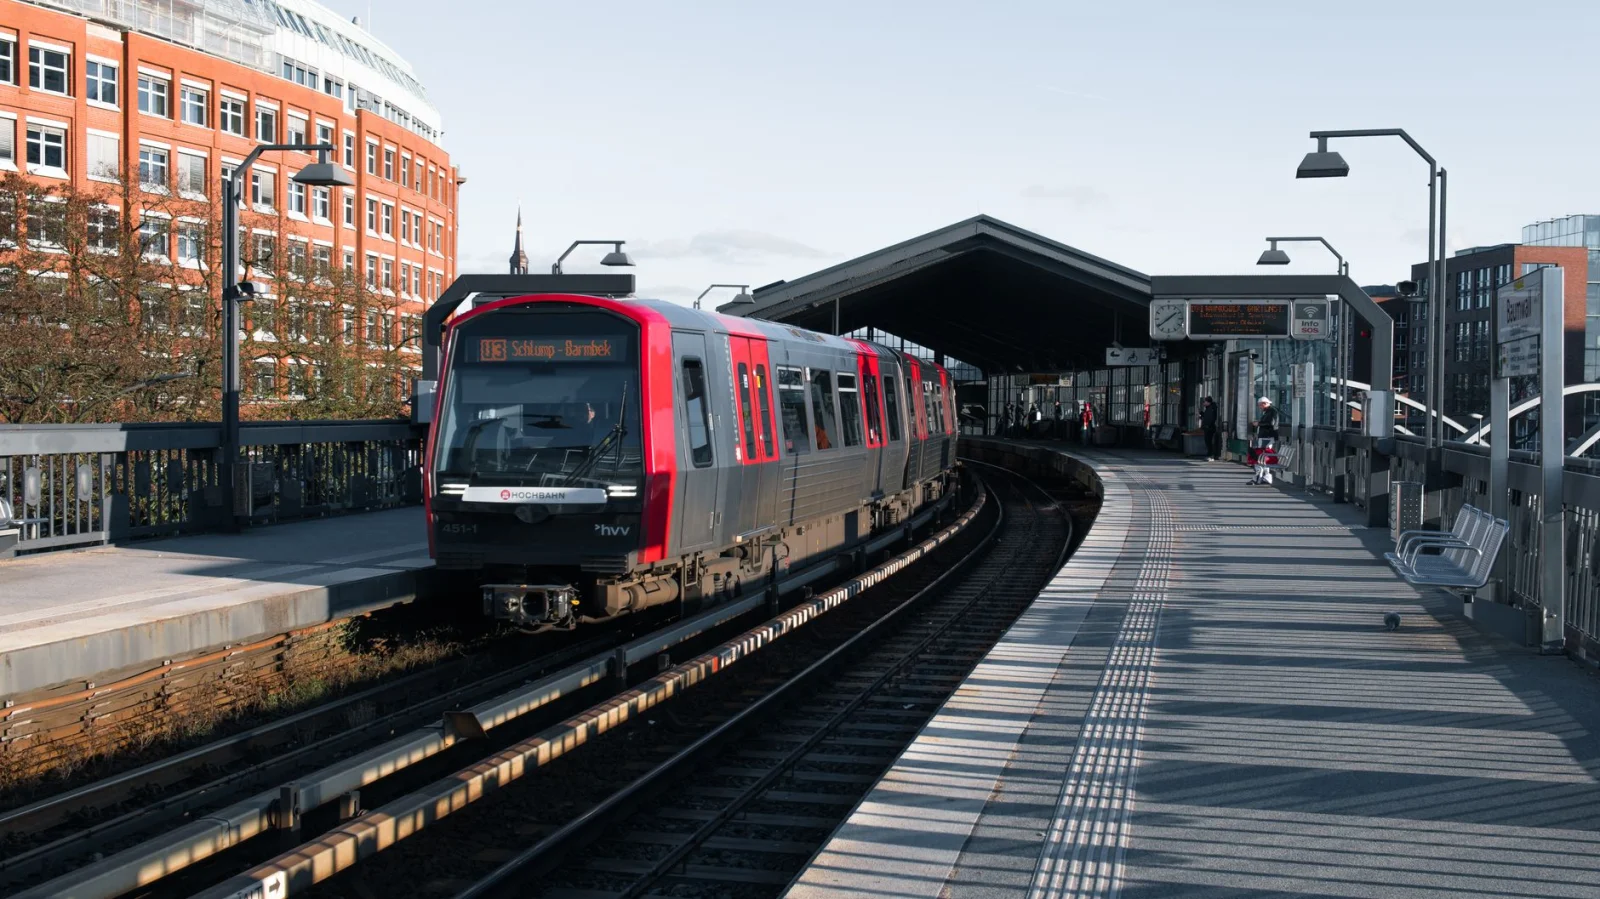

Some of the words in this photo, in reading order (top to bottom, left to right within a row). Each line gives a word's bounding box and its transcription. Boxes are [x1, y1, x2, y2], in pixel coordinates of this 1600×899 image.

[481, 339, 507, 361] U3
[511, 339, 554, 358] Schlump
[565, 339, 612, 357] Barmbek
[511, 491, 566, 500] HOCHBAHN
[442, 523, 477, 534] 451-1
